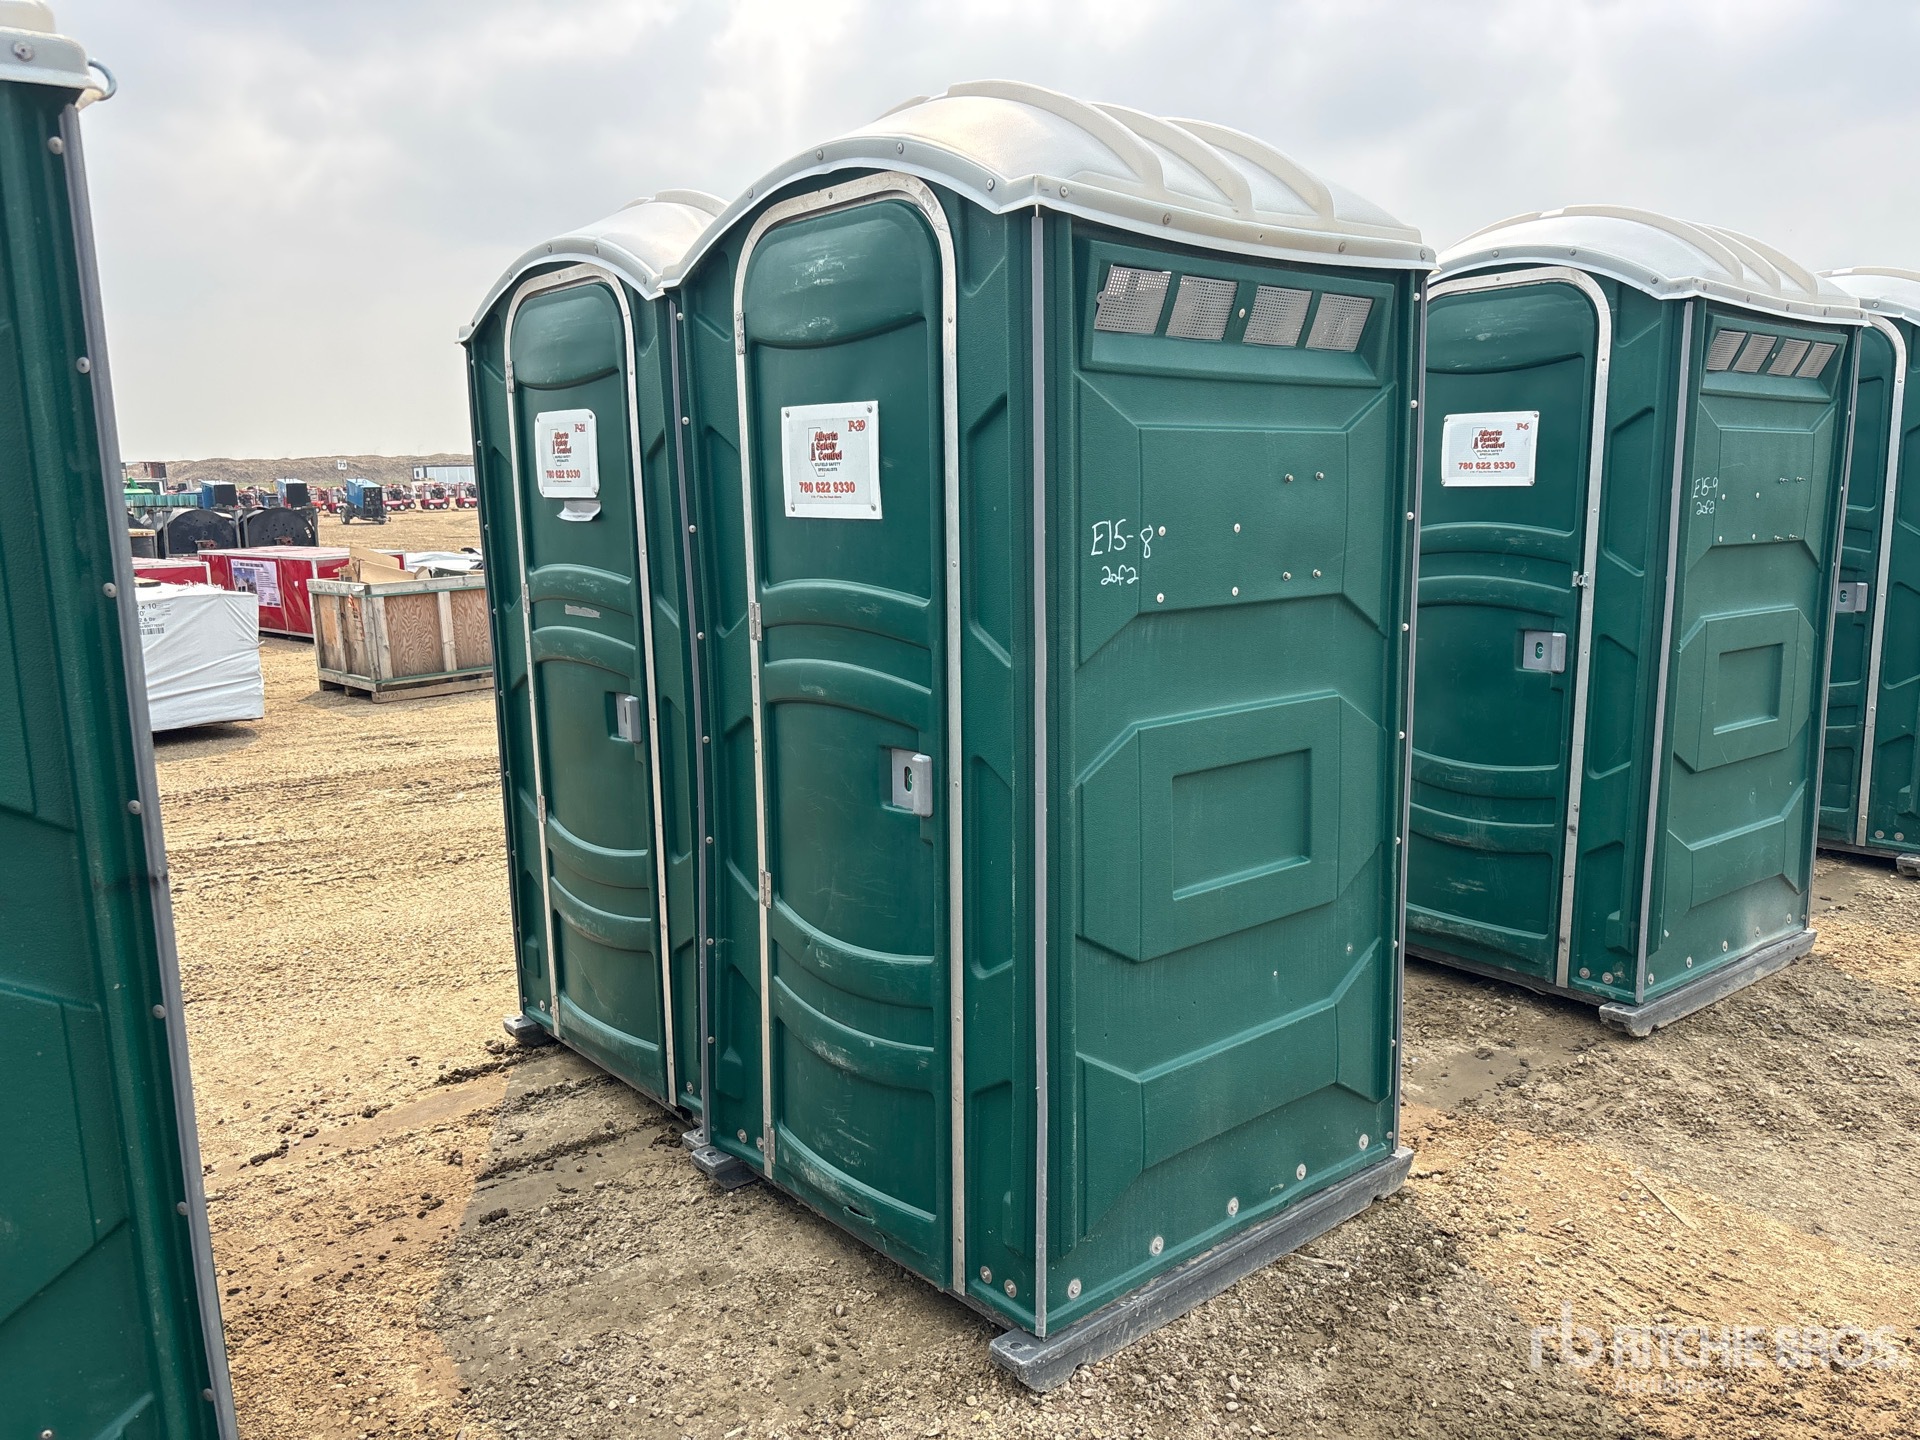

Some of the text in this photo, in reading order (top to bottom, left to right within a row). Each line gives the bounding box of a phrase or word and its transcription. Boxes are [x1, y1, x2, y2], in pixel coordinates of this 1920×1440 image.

[848, 420, 866, 432] P-39
[815, 431, 838, 442] Alberta
[816, 441, 836, 451] Safety
[818, 450, 842, 461] Control
[566, 470, 581, 478] 9330
[799, 481, 855, 493] 780 622 9330
